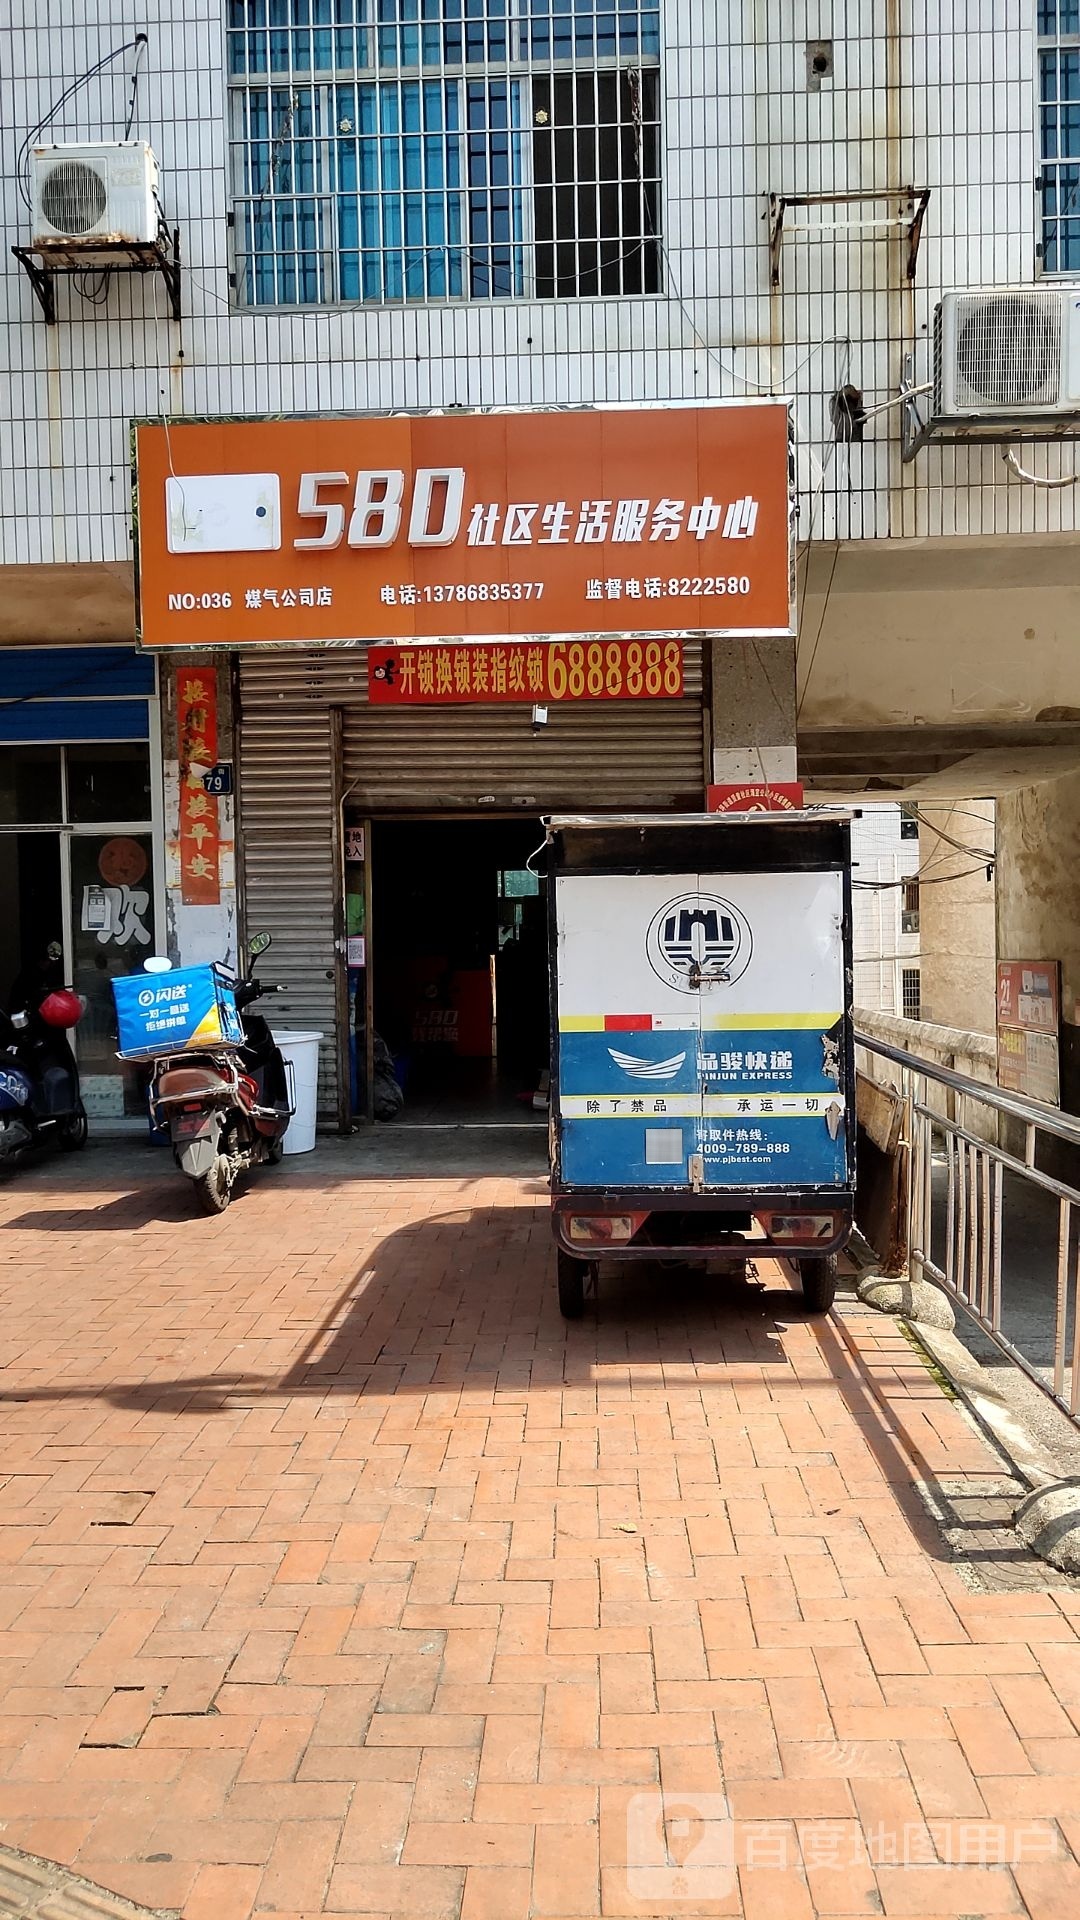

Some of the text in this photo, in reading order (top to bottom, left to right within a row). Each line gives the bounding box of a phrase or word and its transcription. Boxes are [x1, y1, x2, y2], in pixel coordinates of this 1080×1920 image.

[294, 467, 759, 550] 580 社区生活服务中心
[168, 586, 333, 610] NO:036 煤气公司店
[380, 582, 545, 605] 电话:13786835377
[585, 576, 751, 600] 监督电话:8222580
[399, 641, 680, 699] 开锁换锁装指纹锁 6888888
[155, 985, 187, 1003] 闪送
[697, 1051, 793, 1071] 品骏快递
[742, 1072, 793, 1080] EXPRESS
[586, 1098, 820, 1114] 除了禁品 承运一切
[696, 1143, 791, 1154] 4009-789-888
[699, 1155, 772, 1165] ww.pjbest.com
